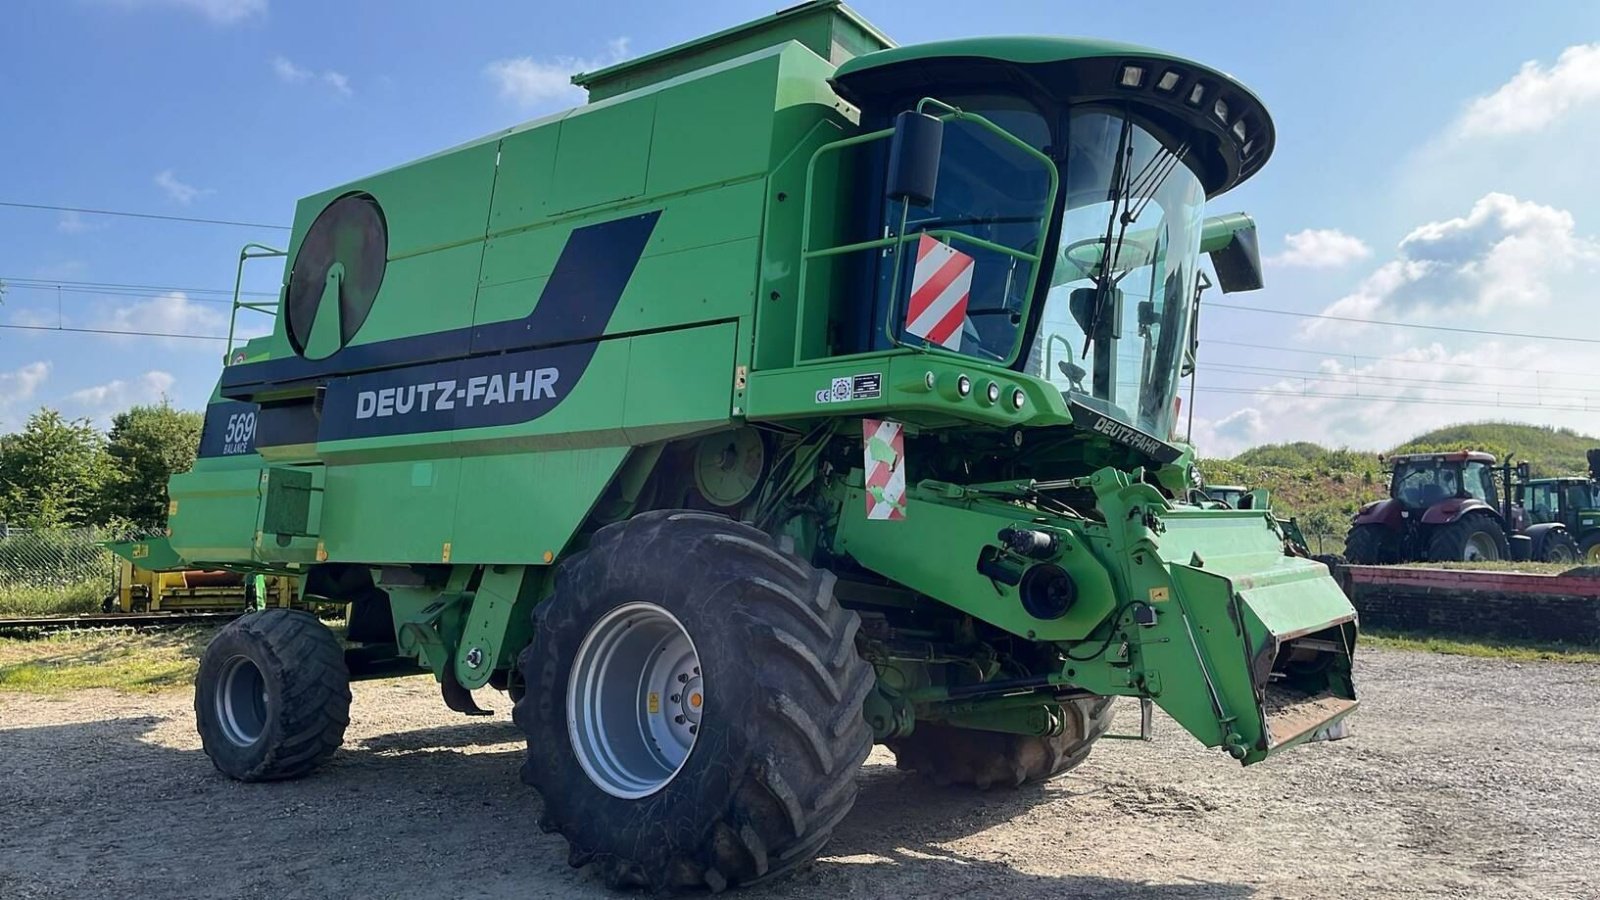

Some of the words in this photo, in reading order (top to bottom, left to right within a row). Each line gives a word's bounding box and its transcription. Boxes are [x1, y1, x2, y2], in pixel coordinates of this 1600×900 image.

[356, 367, 559, 419] DEUTZ-FAHR
[225, 412, 257, 443] 569
[1093, 417, 1160, 454] DEUTZ-FAHR
[223, 441, 247, 454] BALANCE
